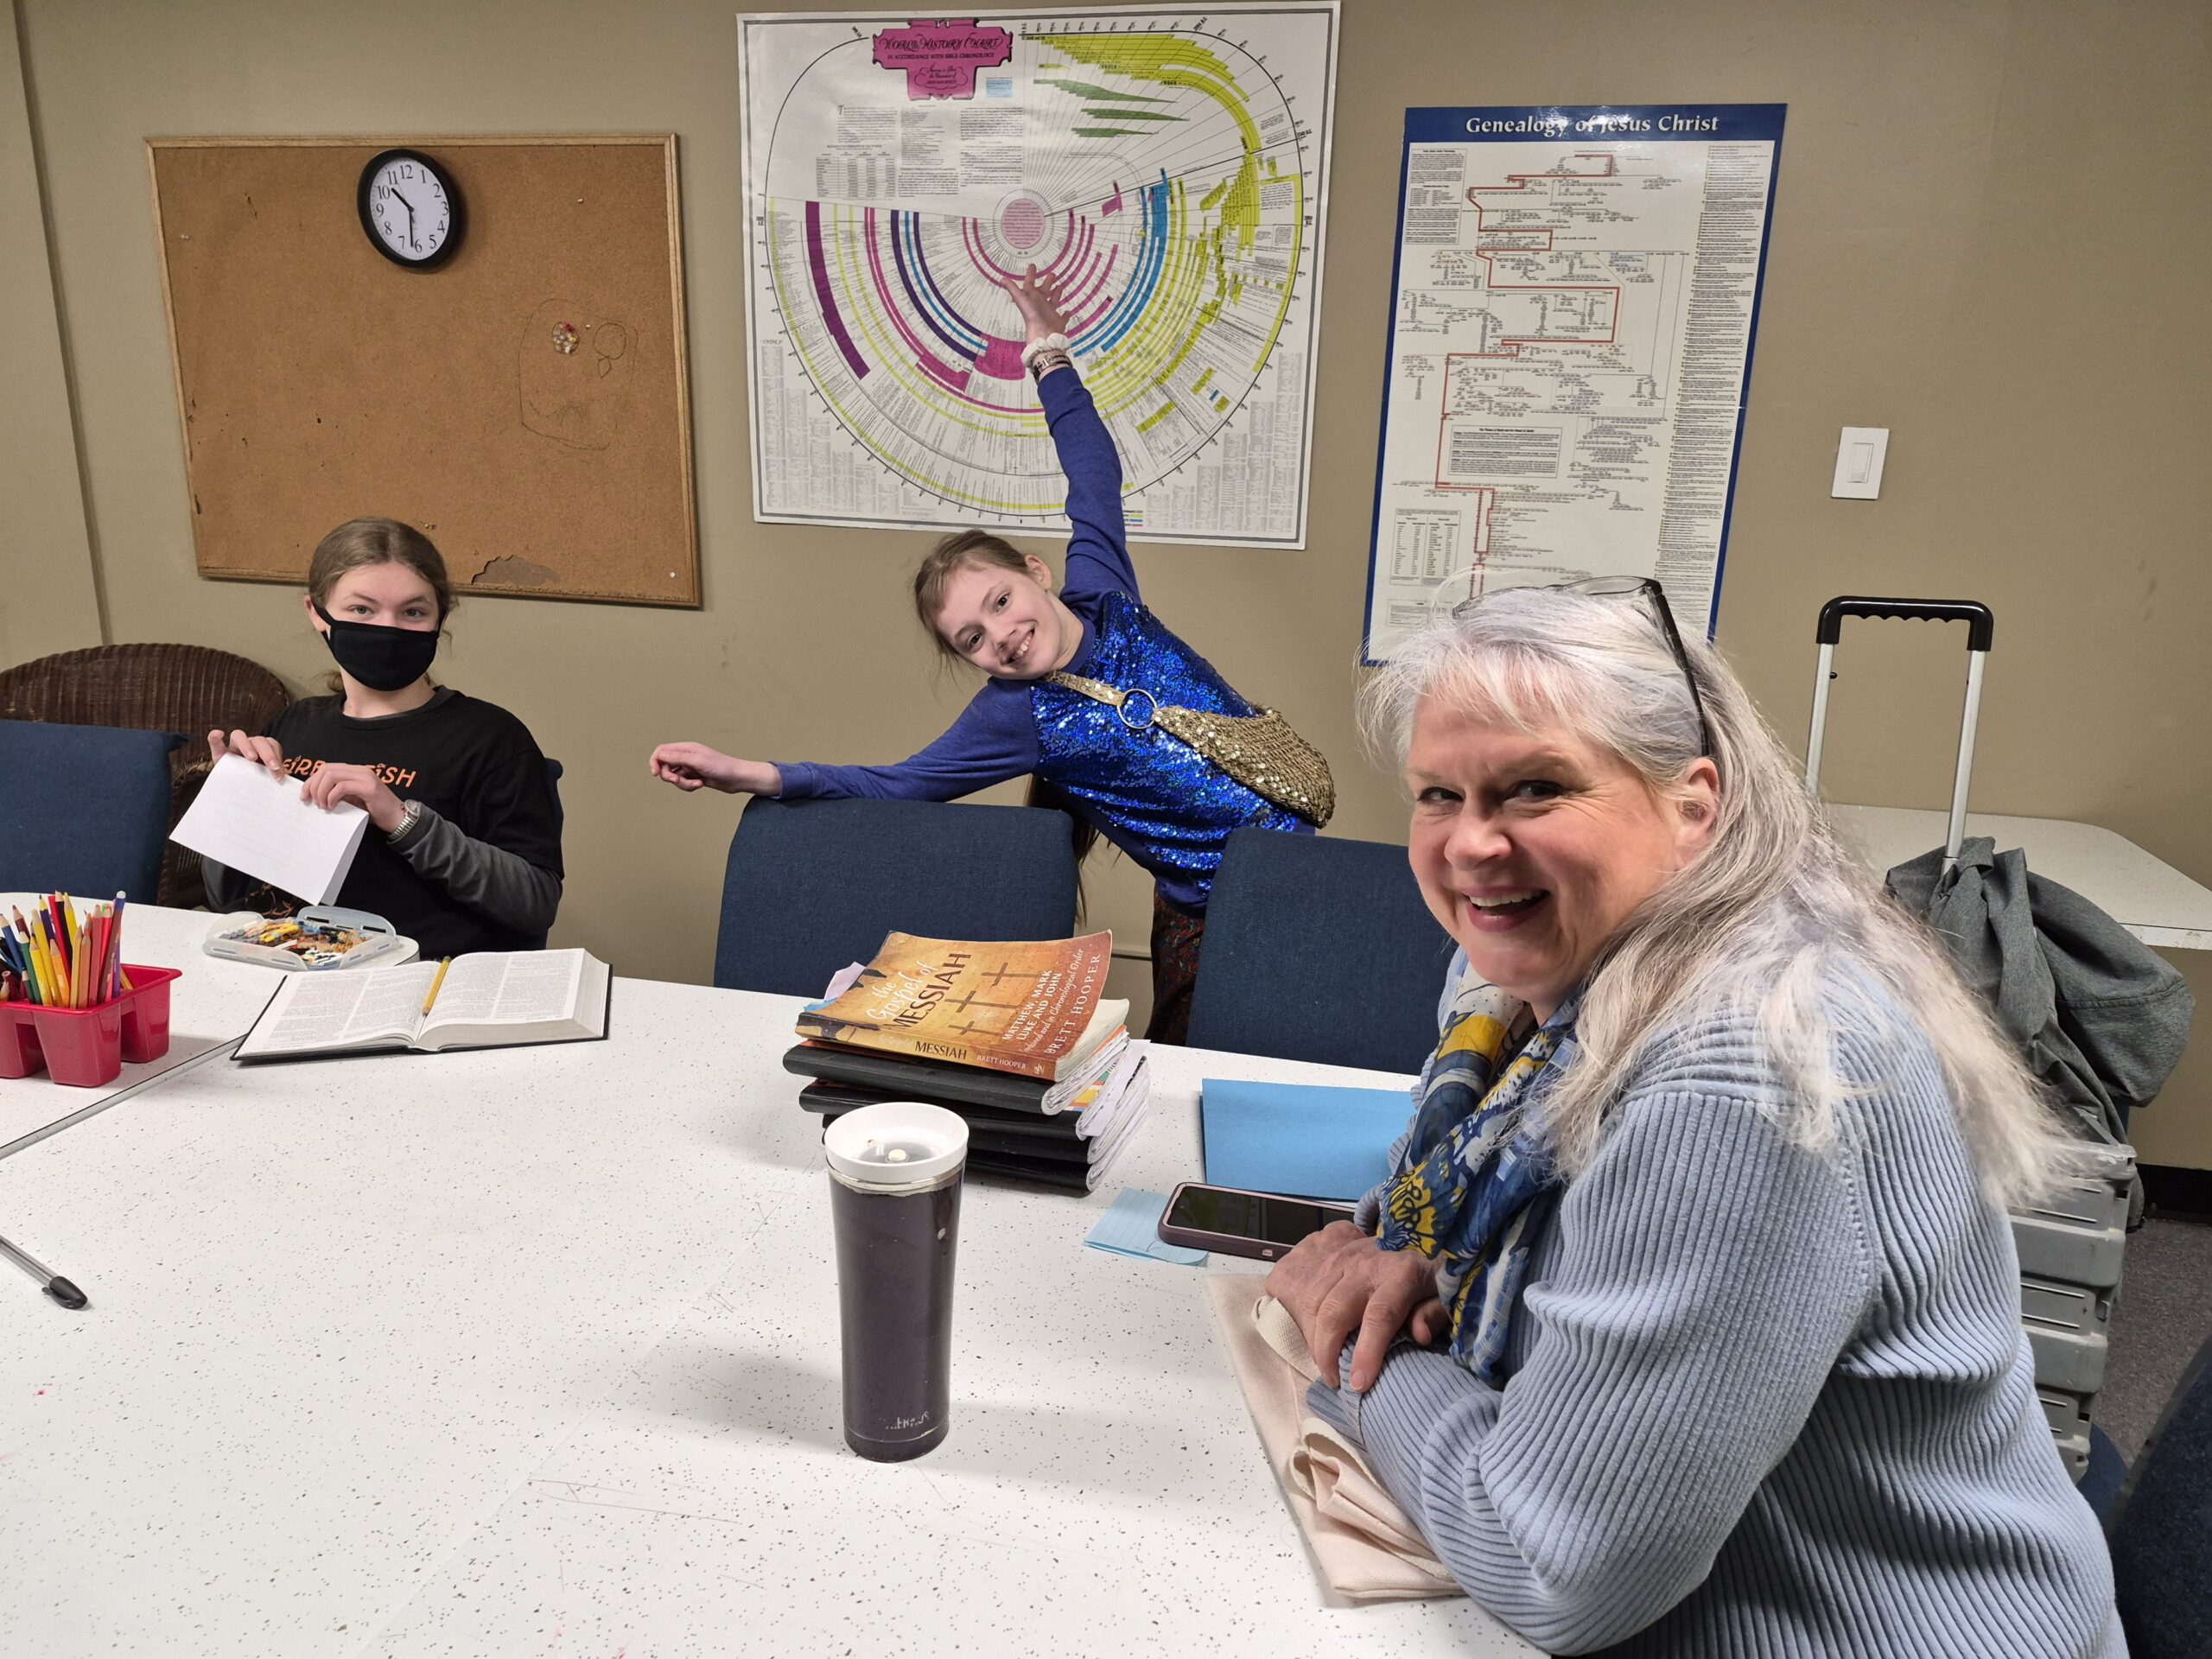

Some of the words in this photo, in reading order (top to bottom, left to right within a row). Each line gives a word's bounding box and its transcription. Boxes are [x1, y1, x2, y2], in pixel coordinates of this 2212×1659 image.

[880, 36, 918, 52] WORLD
[916, 34, 963, 50] HISTORY
[964, 33, 1003, 50] CHART
[1465, 115, 1569, 137] Genealogy
[1574, 115, 1598, 133] of
[1599, 116, 1651, 135] Jesus
[1657, 114, 1719, 131] Christ
[387, 170, 398, 185] 11
[399, 164, 414, 180] 12
[421, 169, 427, 184] 1
[377, 185, 391, 200] 10
[433, 183, 442, 198] 2
[376, 203, 385, 217] 9
[442, 201, 449, 216] 3
[384, 221, 392, 235] 8
[437, 219, 445, 234] 4
[397, 236, 405, 249] 7
[414, 238, 423, 253] 6
[429, 234, 437, 249] 5
[1070, 949, 1084, 970] Order
[867, 971, 924, 1020] Gospel
[916, 961, 939, 976] of
[871, 982, 897, 999] the
[882, 953, 971, 1029] MESSIAH
[1050, 970, 1077, 1015] Chronological
[1001, 1001, 1039, 1040] MATTHEW,
[1032, 969, 1052, 997] MARK
[1016, 1020, 1037, 1040] LUKE
[1033, 1001, 1049, 1020] AND
[1045, 973, 1063, 996] JOHN
[1044, 1020, 1076, 1054] BRETT
[1071, 954, 1101, 1014] HOOPER
[1040, 1020, 1051, 1036] and
[1048, 1015, 1056, 1025] in
[915, 1041, 967, 1060] MESSIAH
[976, 1054, 998, 1065] BRETT
[999, 1058, 1027, 1070] HOOPER
